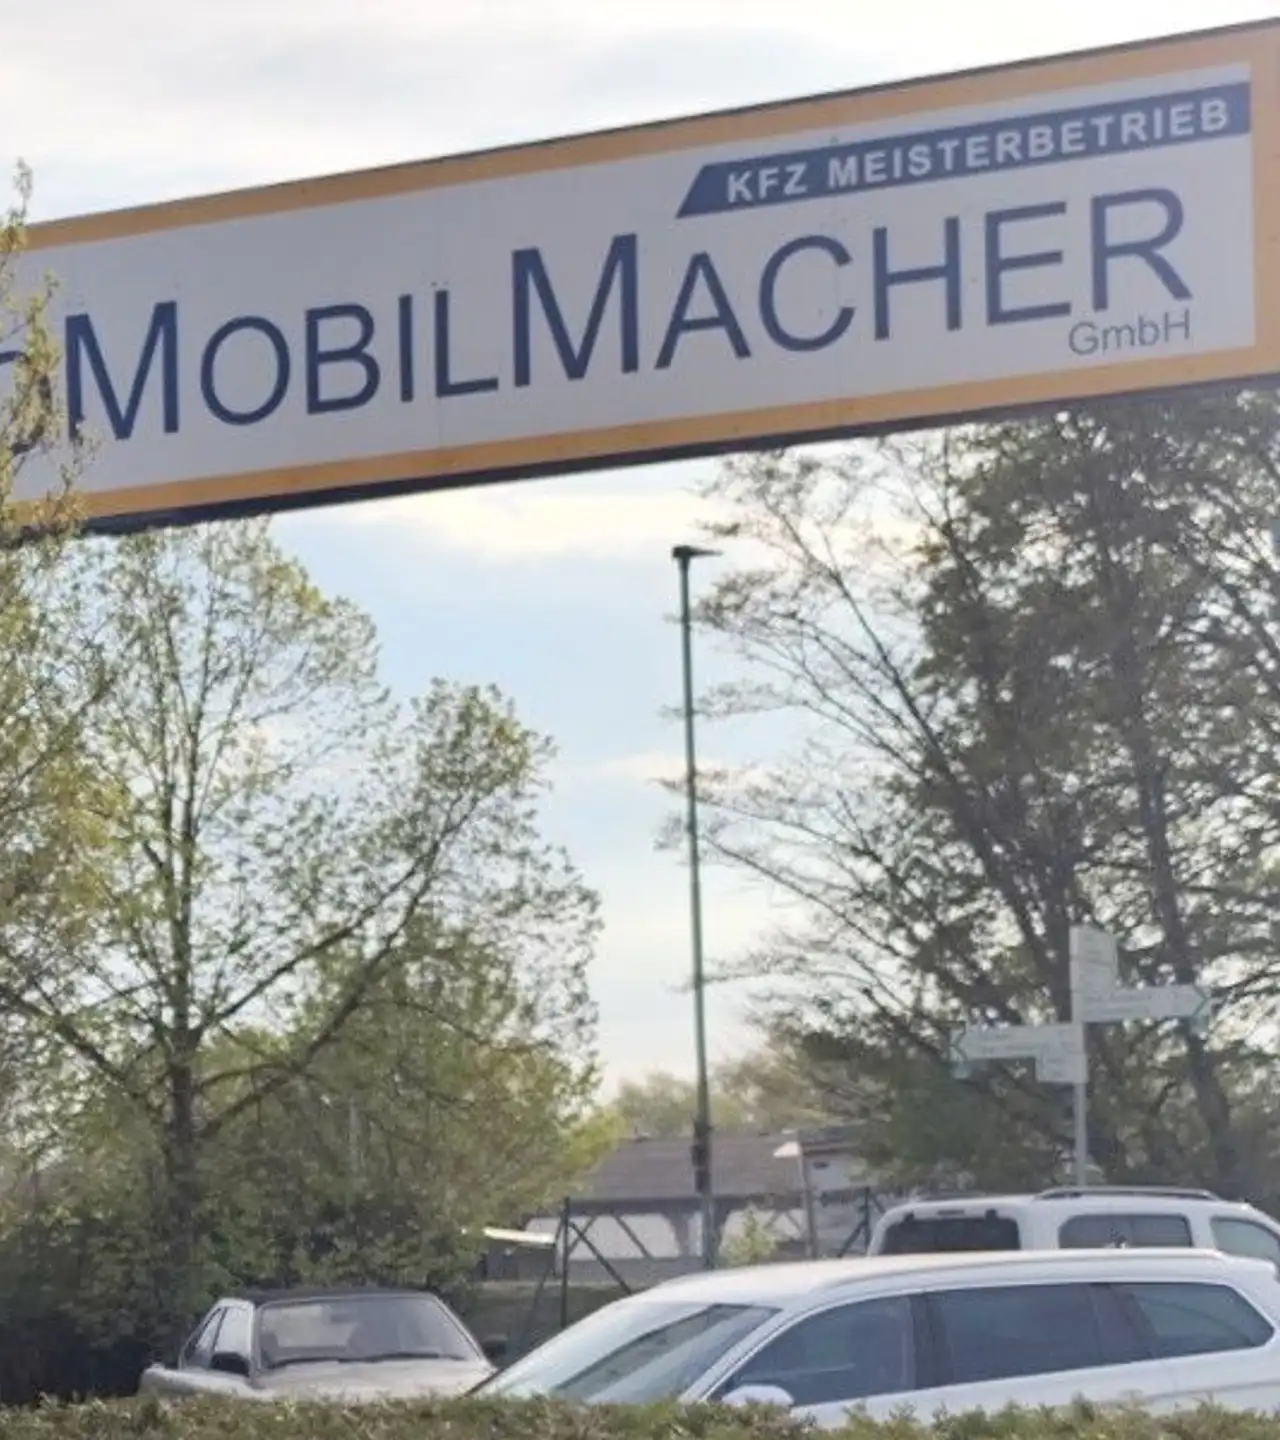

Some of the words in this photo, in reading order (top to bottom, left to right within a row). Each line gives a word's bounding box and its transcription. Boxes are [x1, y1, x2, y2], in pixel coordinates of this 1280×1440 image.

[726, 164, 808, 203] KFZ
[827, 99, 1229, 189] MEISTERBETRIEB
[1068, 310, 1191, 357] GmbH
